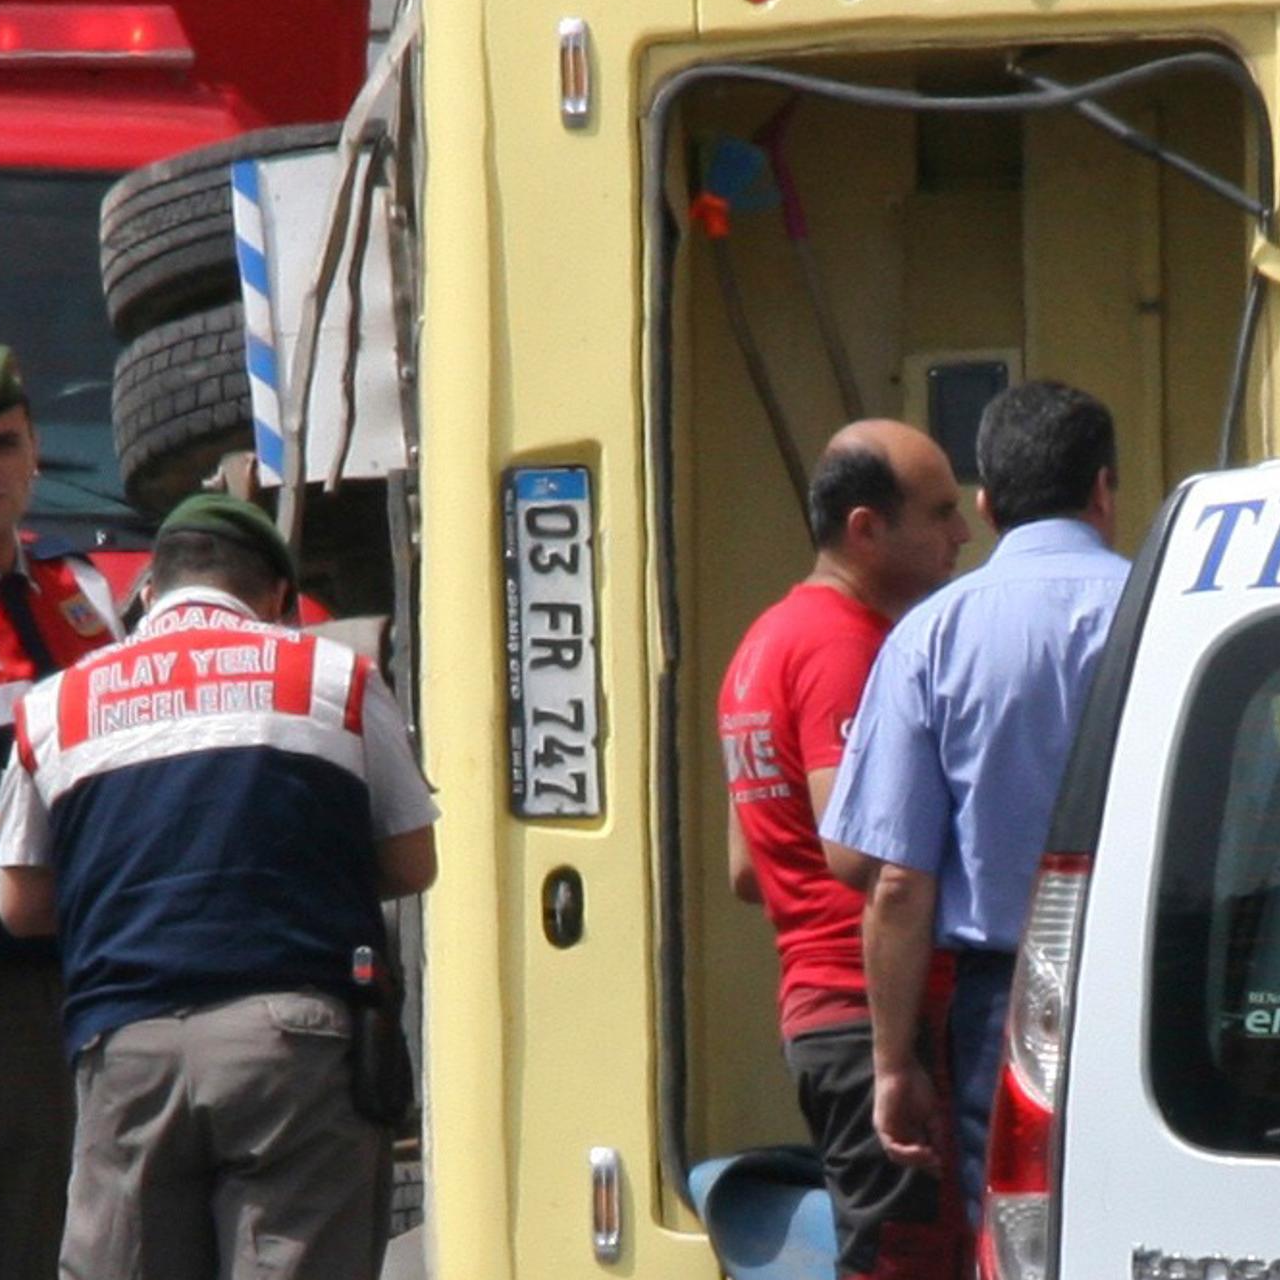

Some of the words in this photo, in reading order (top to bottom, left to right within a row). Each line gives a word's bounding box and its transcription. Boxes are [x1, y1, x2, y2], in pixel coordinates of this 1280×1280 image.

[524, 503, 580, 575] 03
[529, 602, 584, 670] FR
[531, 699, 588, 805] 747
